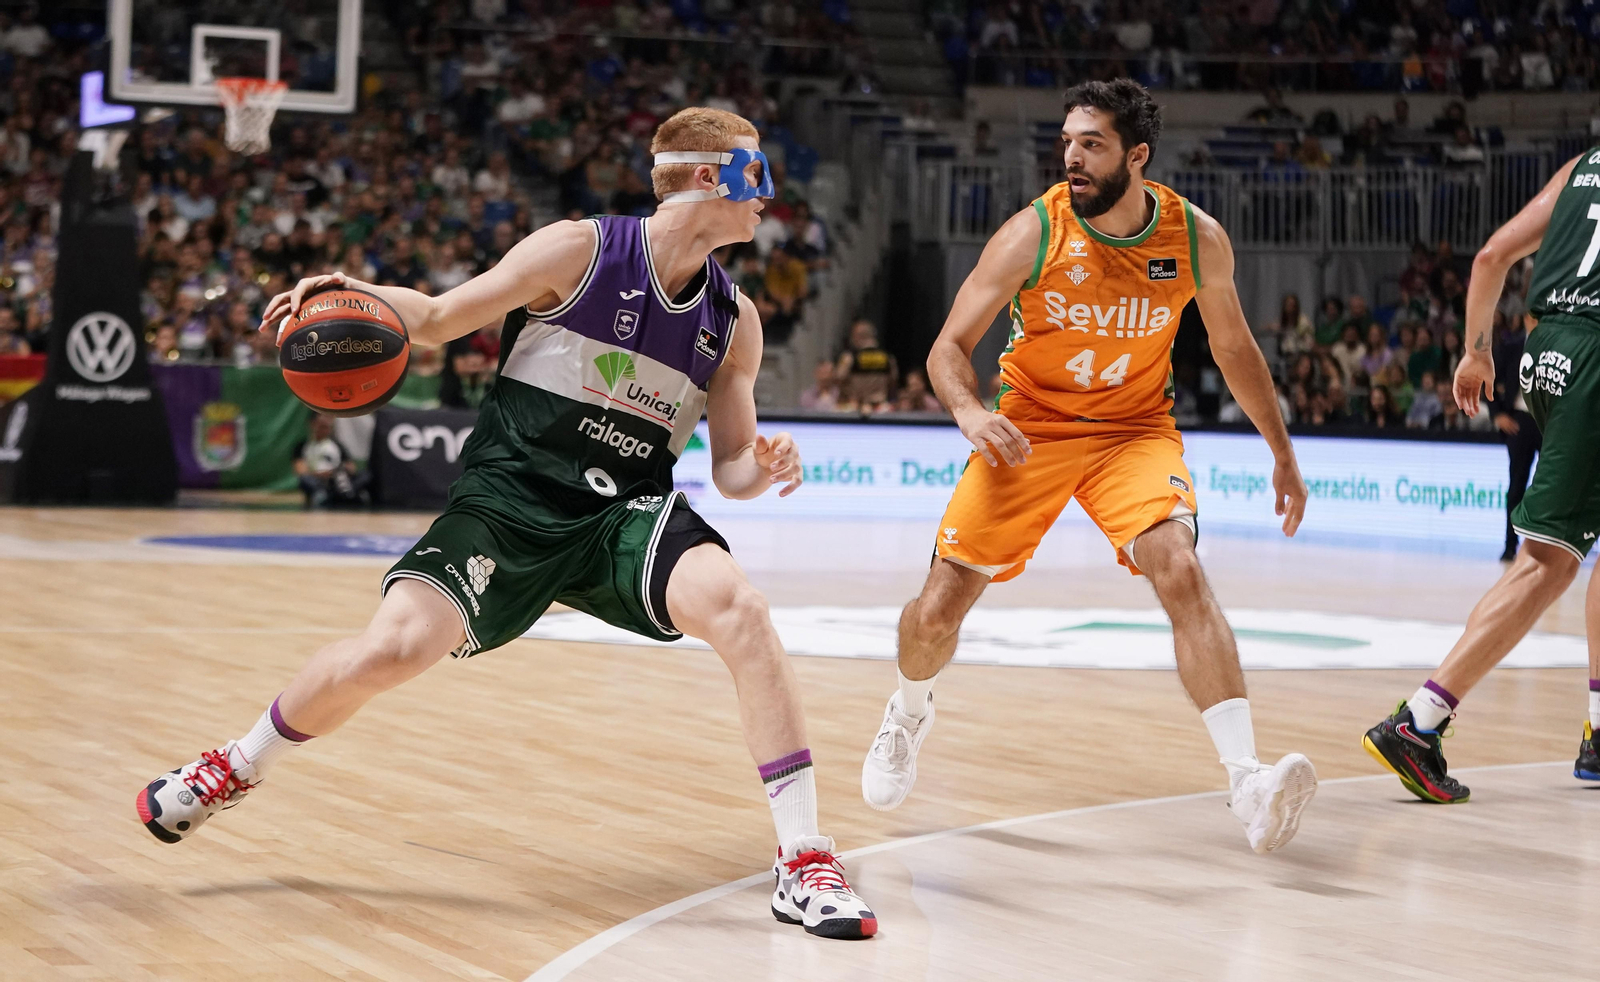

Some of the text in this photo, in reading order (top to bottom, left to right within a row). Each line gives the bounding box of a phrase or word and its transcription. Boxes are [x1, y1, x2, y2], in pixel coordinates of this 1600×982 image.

[1044, 291, 1171, 329] Sevilla
[1065, 349, 1131, 390] 44
[626, 383, 681, 420] Unicaj
[577, 415, 654, 459] málaga
[584, 467, 618, 497] 0
